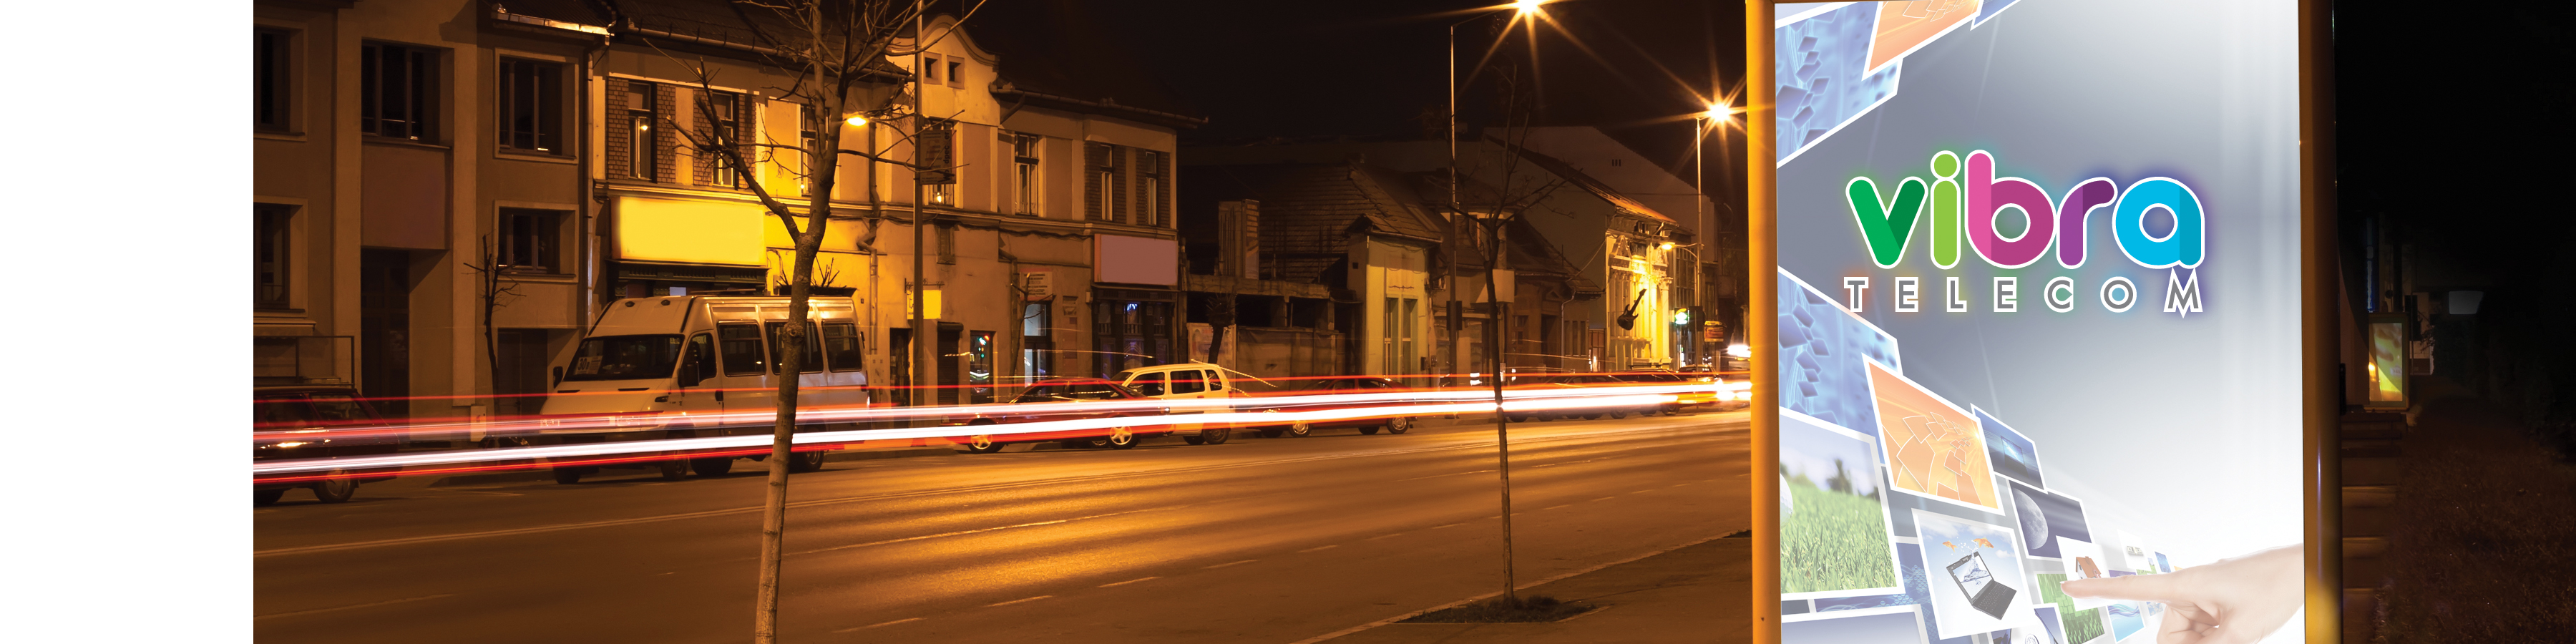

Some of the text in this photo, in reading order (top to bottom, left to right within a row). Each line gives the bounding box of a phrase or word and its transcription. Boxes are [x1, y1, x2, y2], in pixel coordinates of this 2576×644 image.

[940, 132, 950, 182] Wodpecer
[1845, 150, 2205, 270] vibra
[1844, 271, 2203, 318] TELECOM
